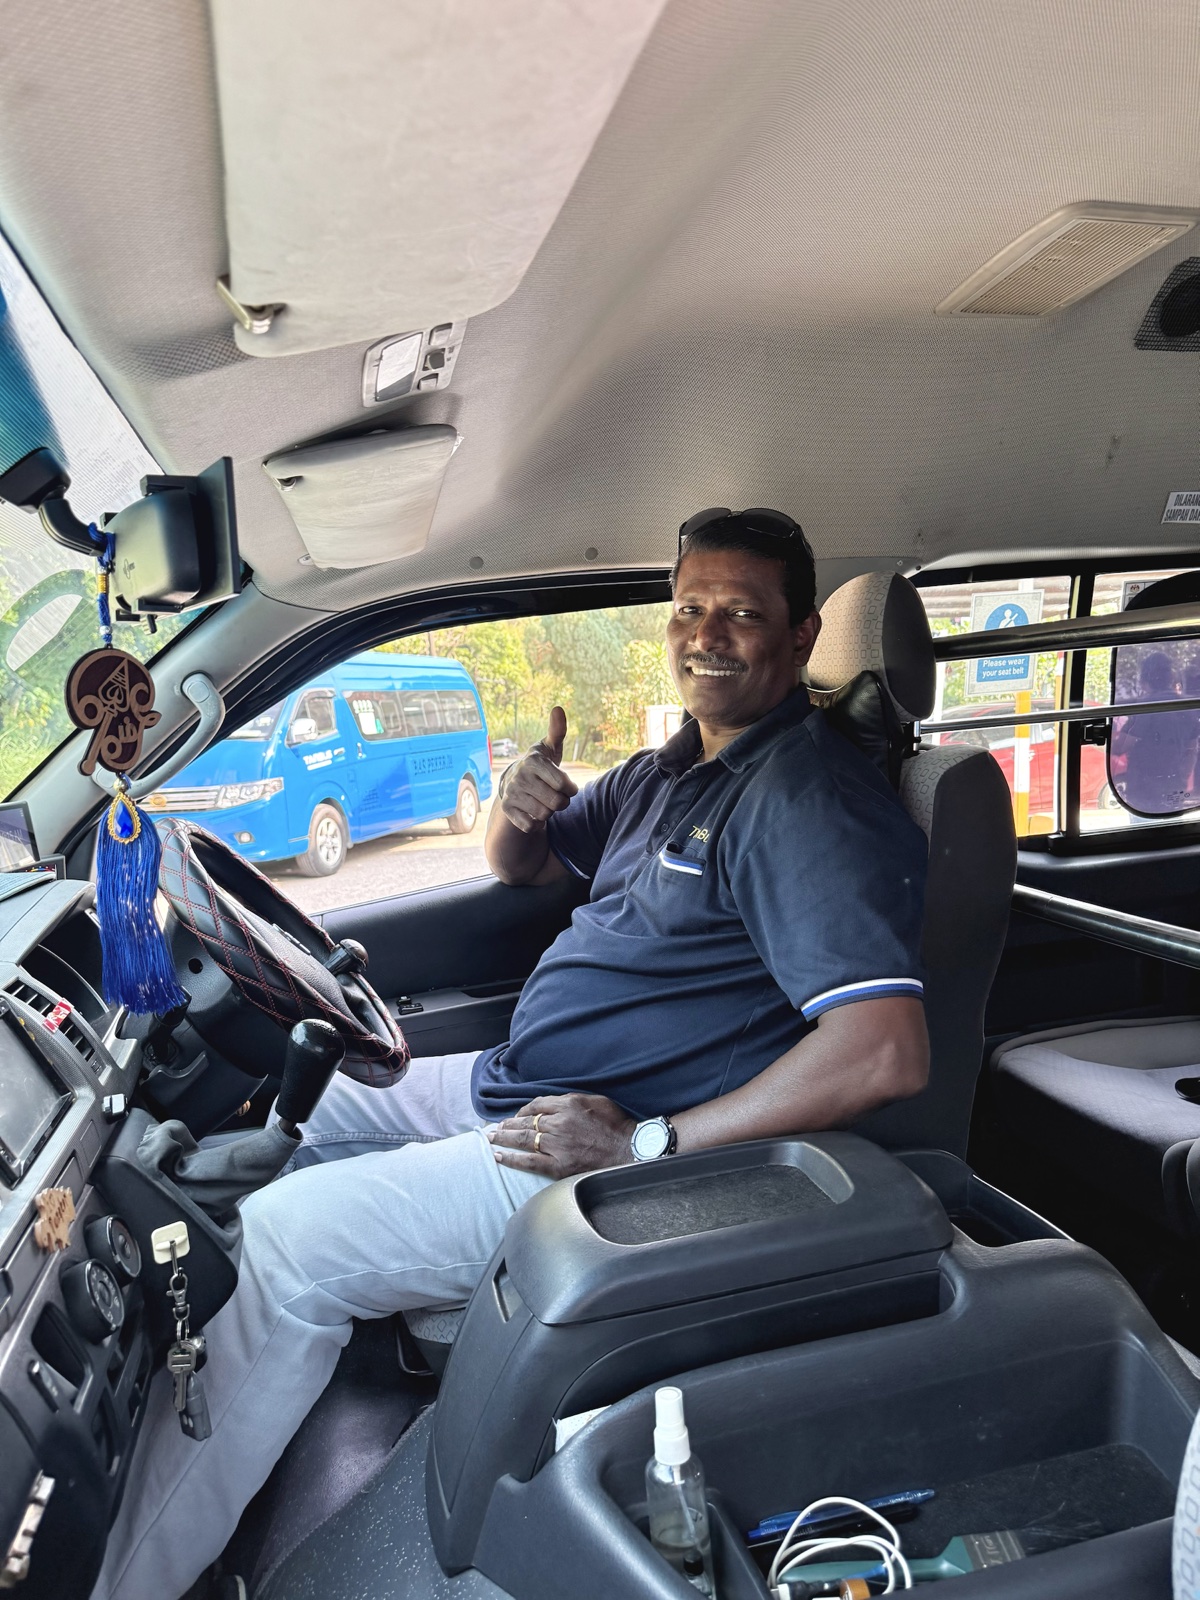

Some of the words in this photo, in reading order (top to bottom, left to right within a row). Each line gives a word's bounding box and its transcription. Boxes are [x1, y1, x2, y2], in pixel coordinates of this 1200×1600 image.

[1164, 508, 1191, 521] SAMPAH
[982, 659, 1006, 667] Please
[1008, 658, 1025, 666] wear
[982, 669, 998, 679] your
[998, 668, 1012, 676] seat
[1012, 666, 1024, 675] belt
